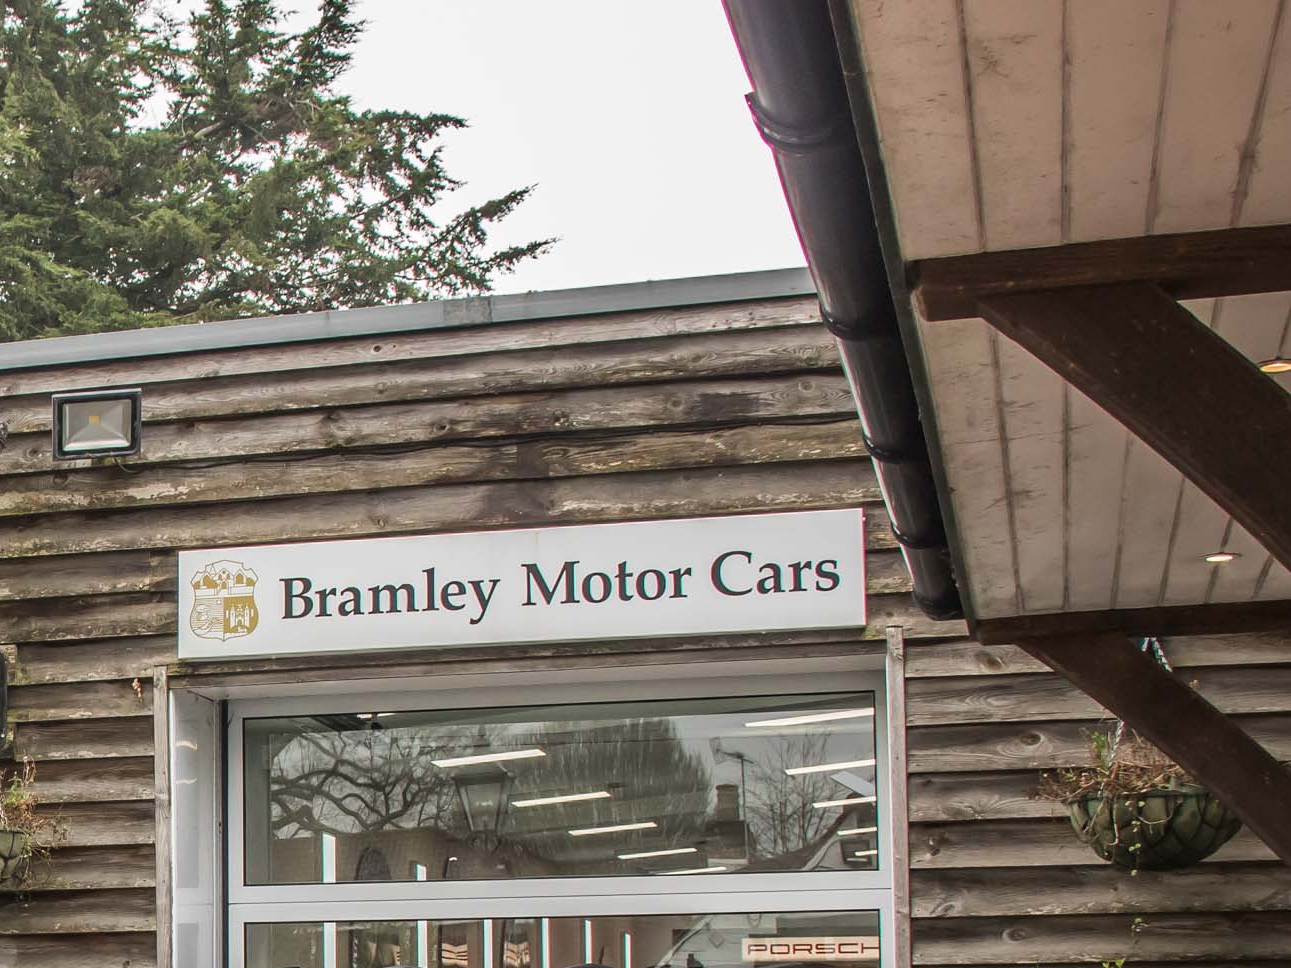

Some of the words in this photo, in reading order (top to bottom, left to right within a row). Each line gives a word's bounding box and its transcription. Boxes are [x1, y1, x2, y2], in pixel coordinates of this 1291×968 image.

[279, 567, 501, 625] Bramley
[520, 560, 692, 606] Motor
[710, 550, 841, 597] Cars
